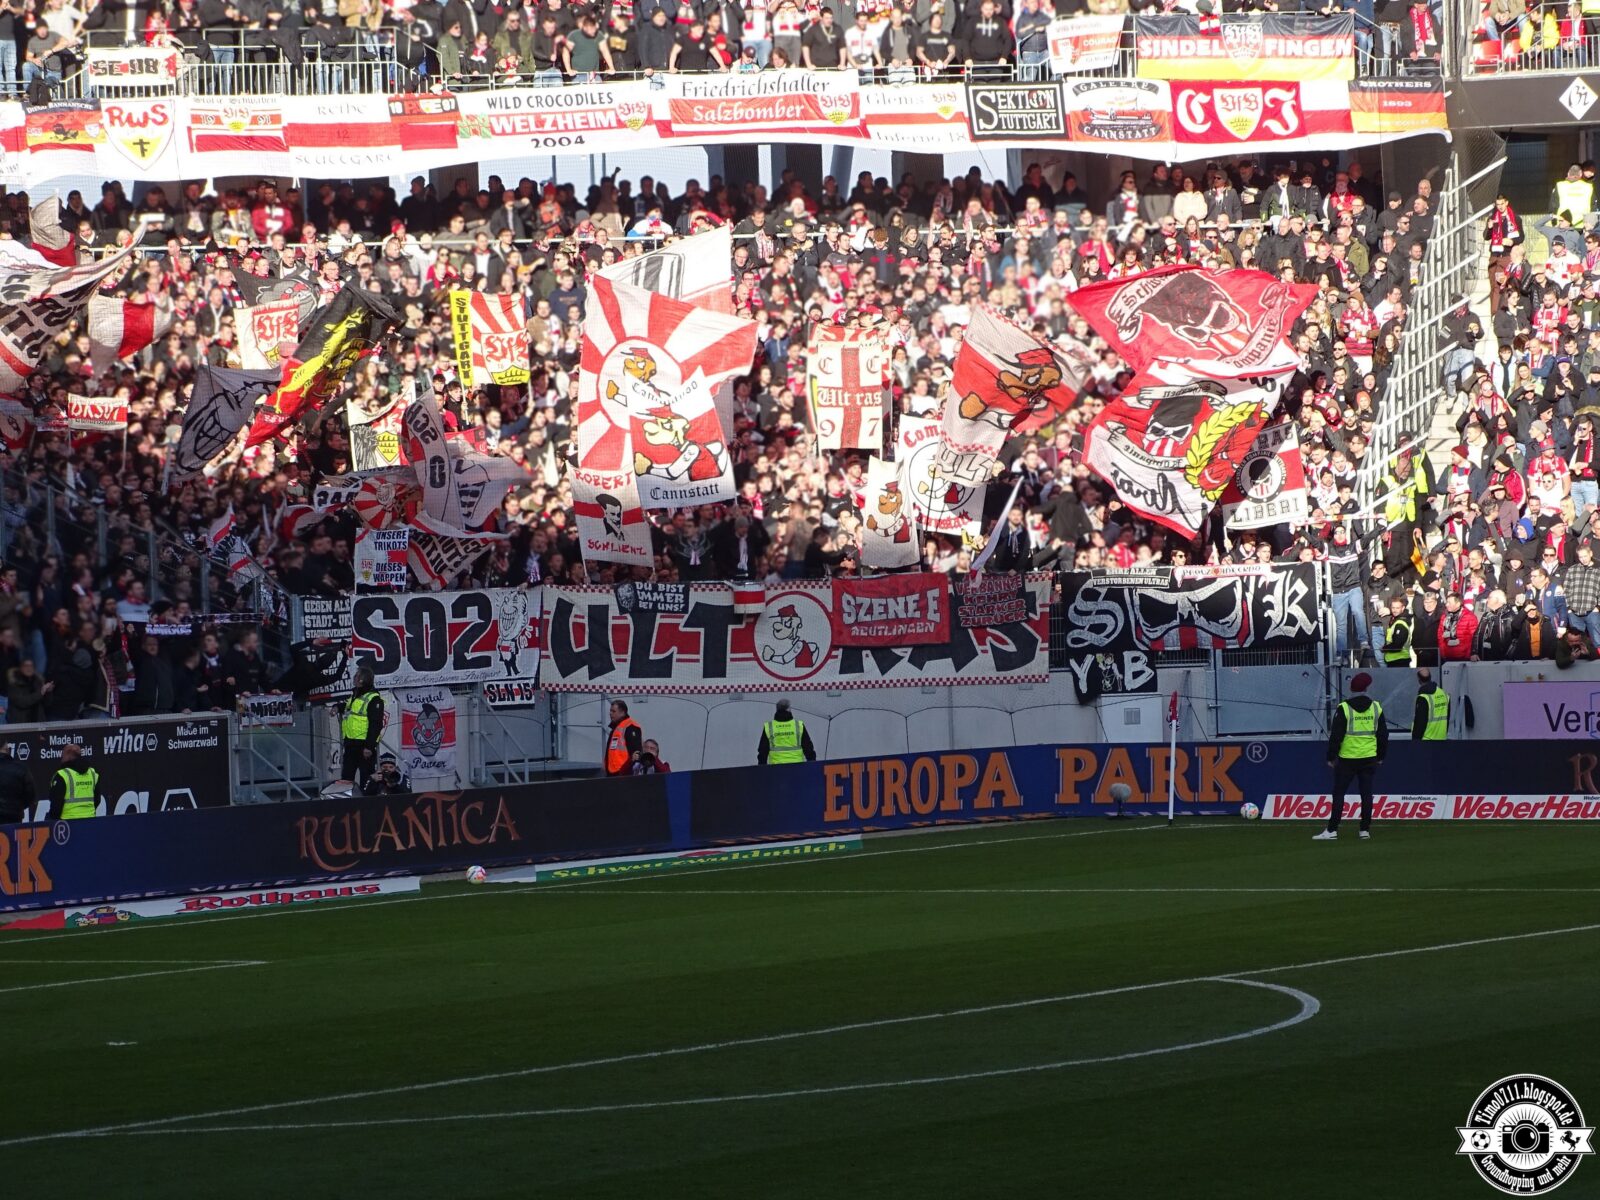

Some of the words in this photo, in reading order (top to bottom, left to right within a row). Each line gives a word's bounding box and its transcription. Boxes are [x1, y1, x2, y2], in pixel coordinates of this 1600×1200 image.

[1138, 38, 1224, 57] SINDEL
[1265, 37, 1353, 58] FINGEN
[92, 60, 123, 76] SE
[680, 71, 831, 97] Friedrichshaller
[1359, 80, 1432, 88] BROTHERS
[486, 96, 523, 110] WILD
[526, 91, 613, 107] CROCODILES
[693, 98, 805, 122] Salzbomber
[490, 110, 617, 135] WELZHEIM
[530, 135, 586, 148] 2004
[1083, 126, 1157, 141] CANNSTATT
[455, 297, 472, 380] STUTTGART
[574, 469, 633, 490] ROBERT
[650, 482, 720, 501] Cannstatt
[375, 529, 408, 541] UNSERE
[374, 540, 408, 551] TRIKOTS
[375, 562, 403, 573] DIESES
[373, 572, 406, 583] WAPPEN
[1144, 577, 1169, 587] ULTRAS
[635, 582, 652, 591] DU
[657, 583, 686, 594] BIST
[637, 592, 685, 604] IMMER
[842, 592, 921, 625] SZENE
[927, 587, 941, 624] E
[303, 600, 333, 613] GEGEN
[657, 602, 686, 612] UNS!
[304, 614, 338, 628] STADT-
[851, 622, 936, 637] REUTLINGEN
[486, 683, 516, 703] SLN
[519, 682, 533, 700] 15
[1542, 702, 1600, 732] Ver
[176, 725, 198, 737] Made
[199, 724, 209, 735] im
[49, 735, 72, 747] Made
[73, 734, 84, 745] im
[103, 729, 144, 755] wiha
[168, 736, 218, 751] Schwarzwald
[823, 752, 1024, 822] EUROPA
[1055, 746, 1244, 805] PARK
[1453, 796, 1600, 819] WeberHau
[296, 791, 522, 872] RULANTICA
[175, 883, 380, 914] Rothaus
